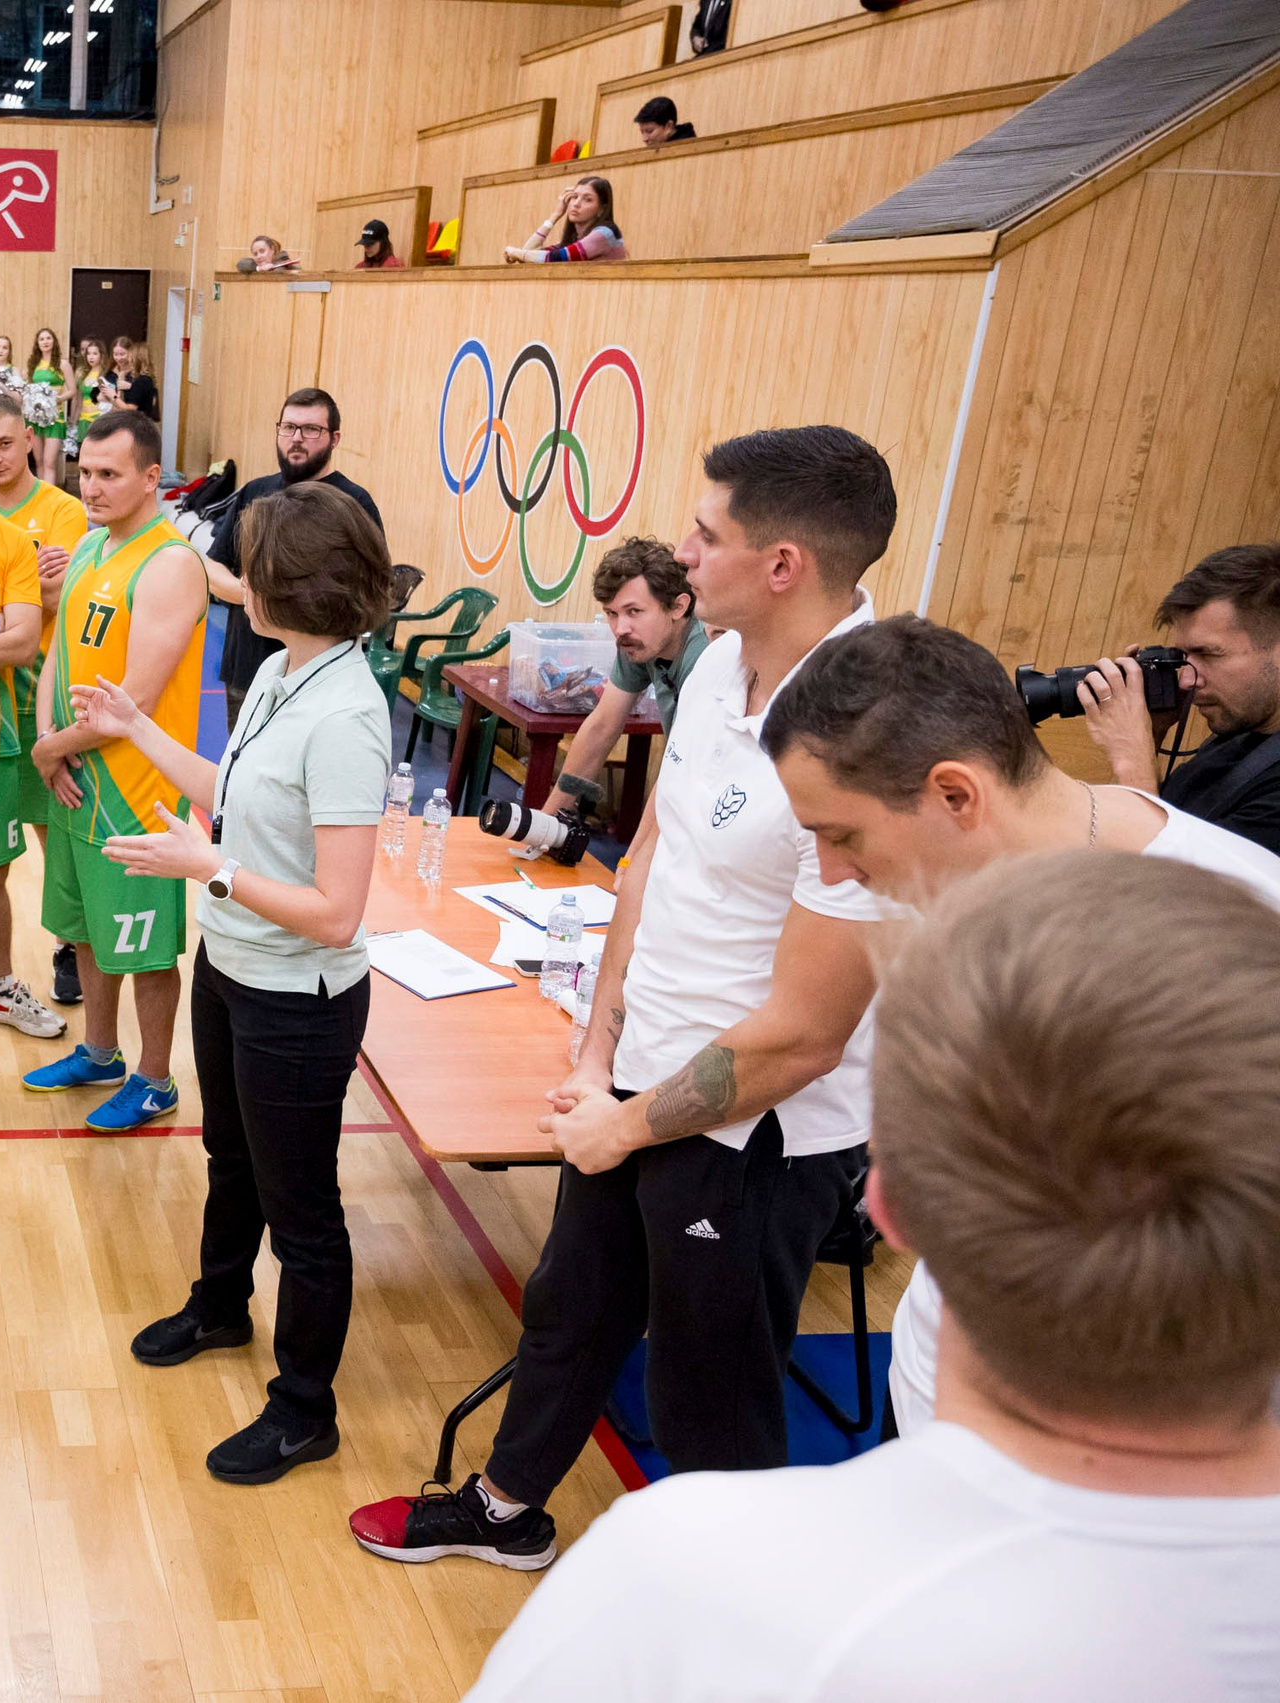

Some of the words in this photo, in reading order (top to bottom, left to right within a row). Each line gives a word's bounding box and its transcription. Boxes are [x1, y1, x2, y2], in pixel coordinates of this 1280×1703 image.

[7, 818, 19, 850] 6
[112, 909, 157, 954] 27
[685, 1228, 721, 1240] adidas
